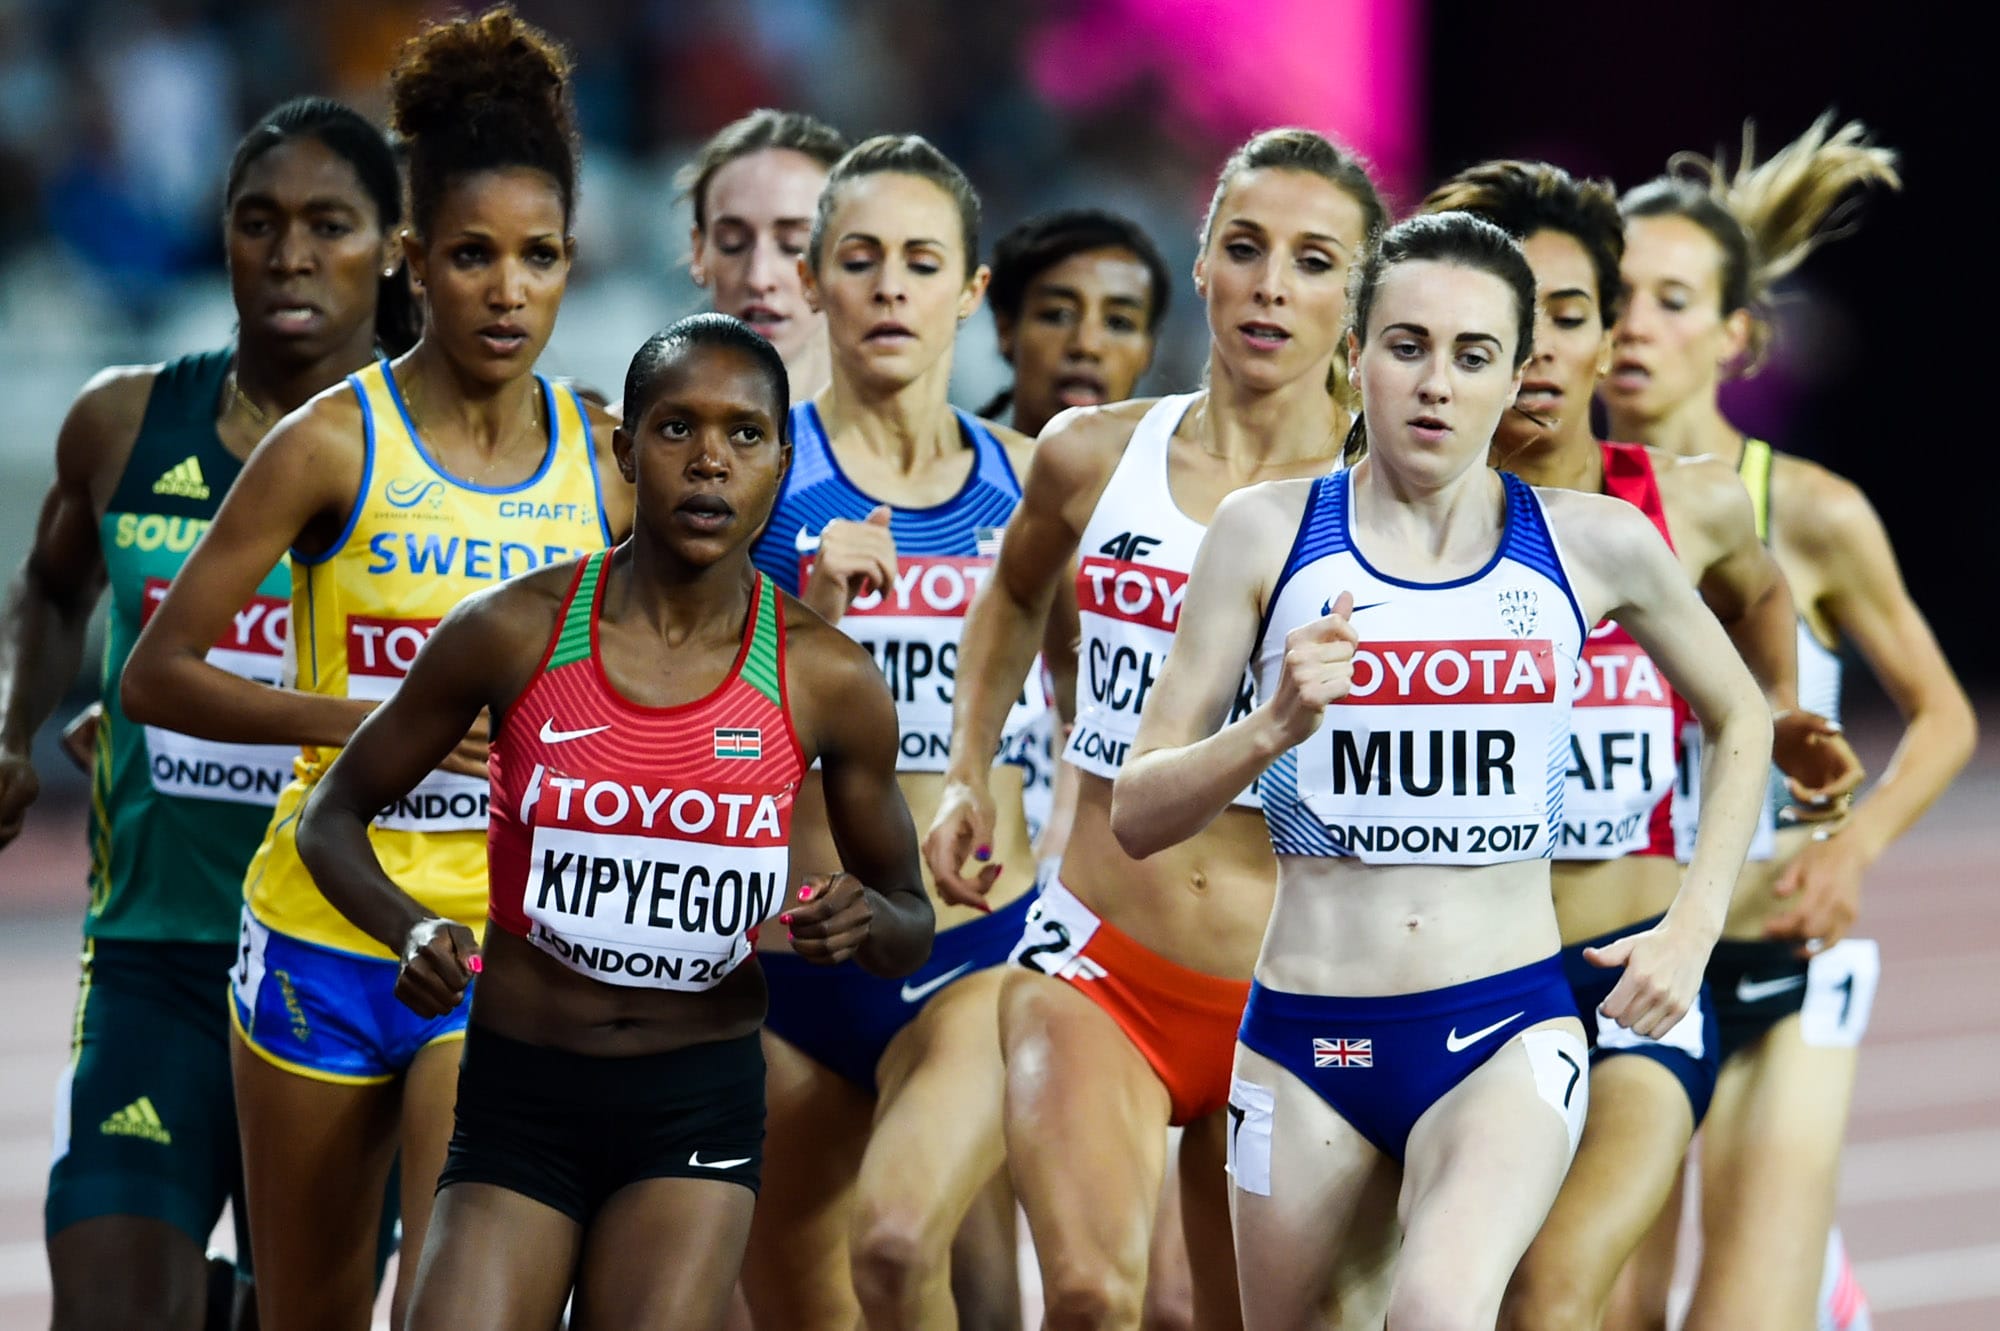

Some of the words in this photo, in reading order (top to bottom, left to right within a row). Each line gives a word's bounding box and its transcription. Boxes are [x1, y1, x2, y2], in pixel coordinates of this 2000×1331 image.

[499, 501, 577, 521] CRAFT
[368, 532, 583, 580] SWEDE
[1099, 531, 1163, 562] 4F
[1346, 649, 1546, 696] OYOTA
[1332, 729, 1516, 797] MUIR
[549, 778, 781, 838] TOYOTA
[1325, 825, 1458, 853] ONDON
[1467, 823, 1540, 853] 2017
[537, 849, 775, 937] KIPYEGON
[540, 926, 683, 980] LONDON
[1834, 972, 1853, 1029] 1
[1557, 1048, 1580, 1111] 7
